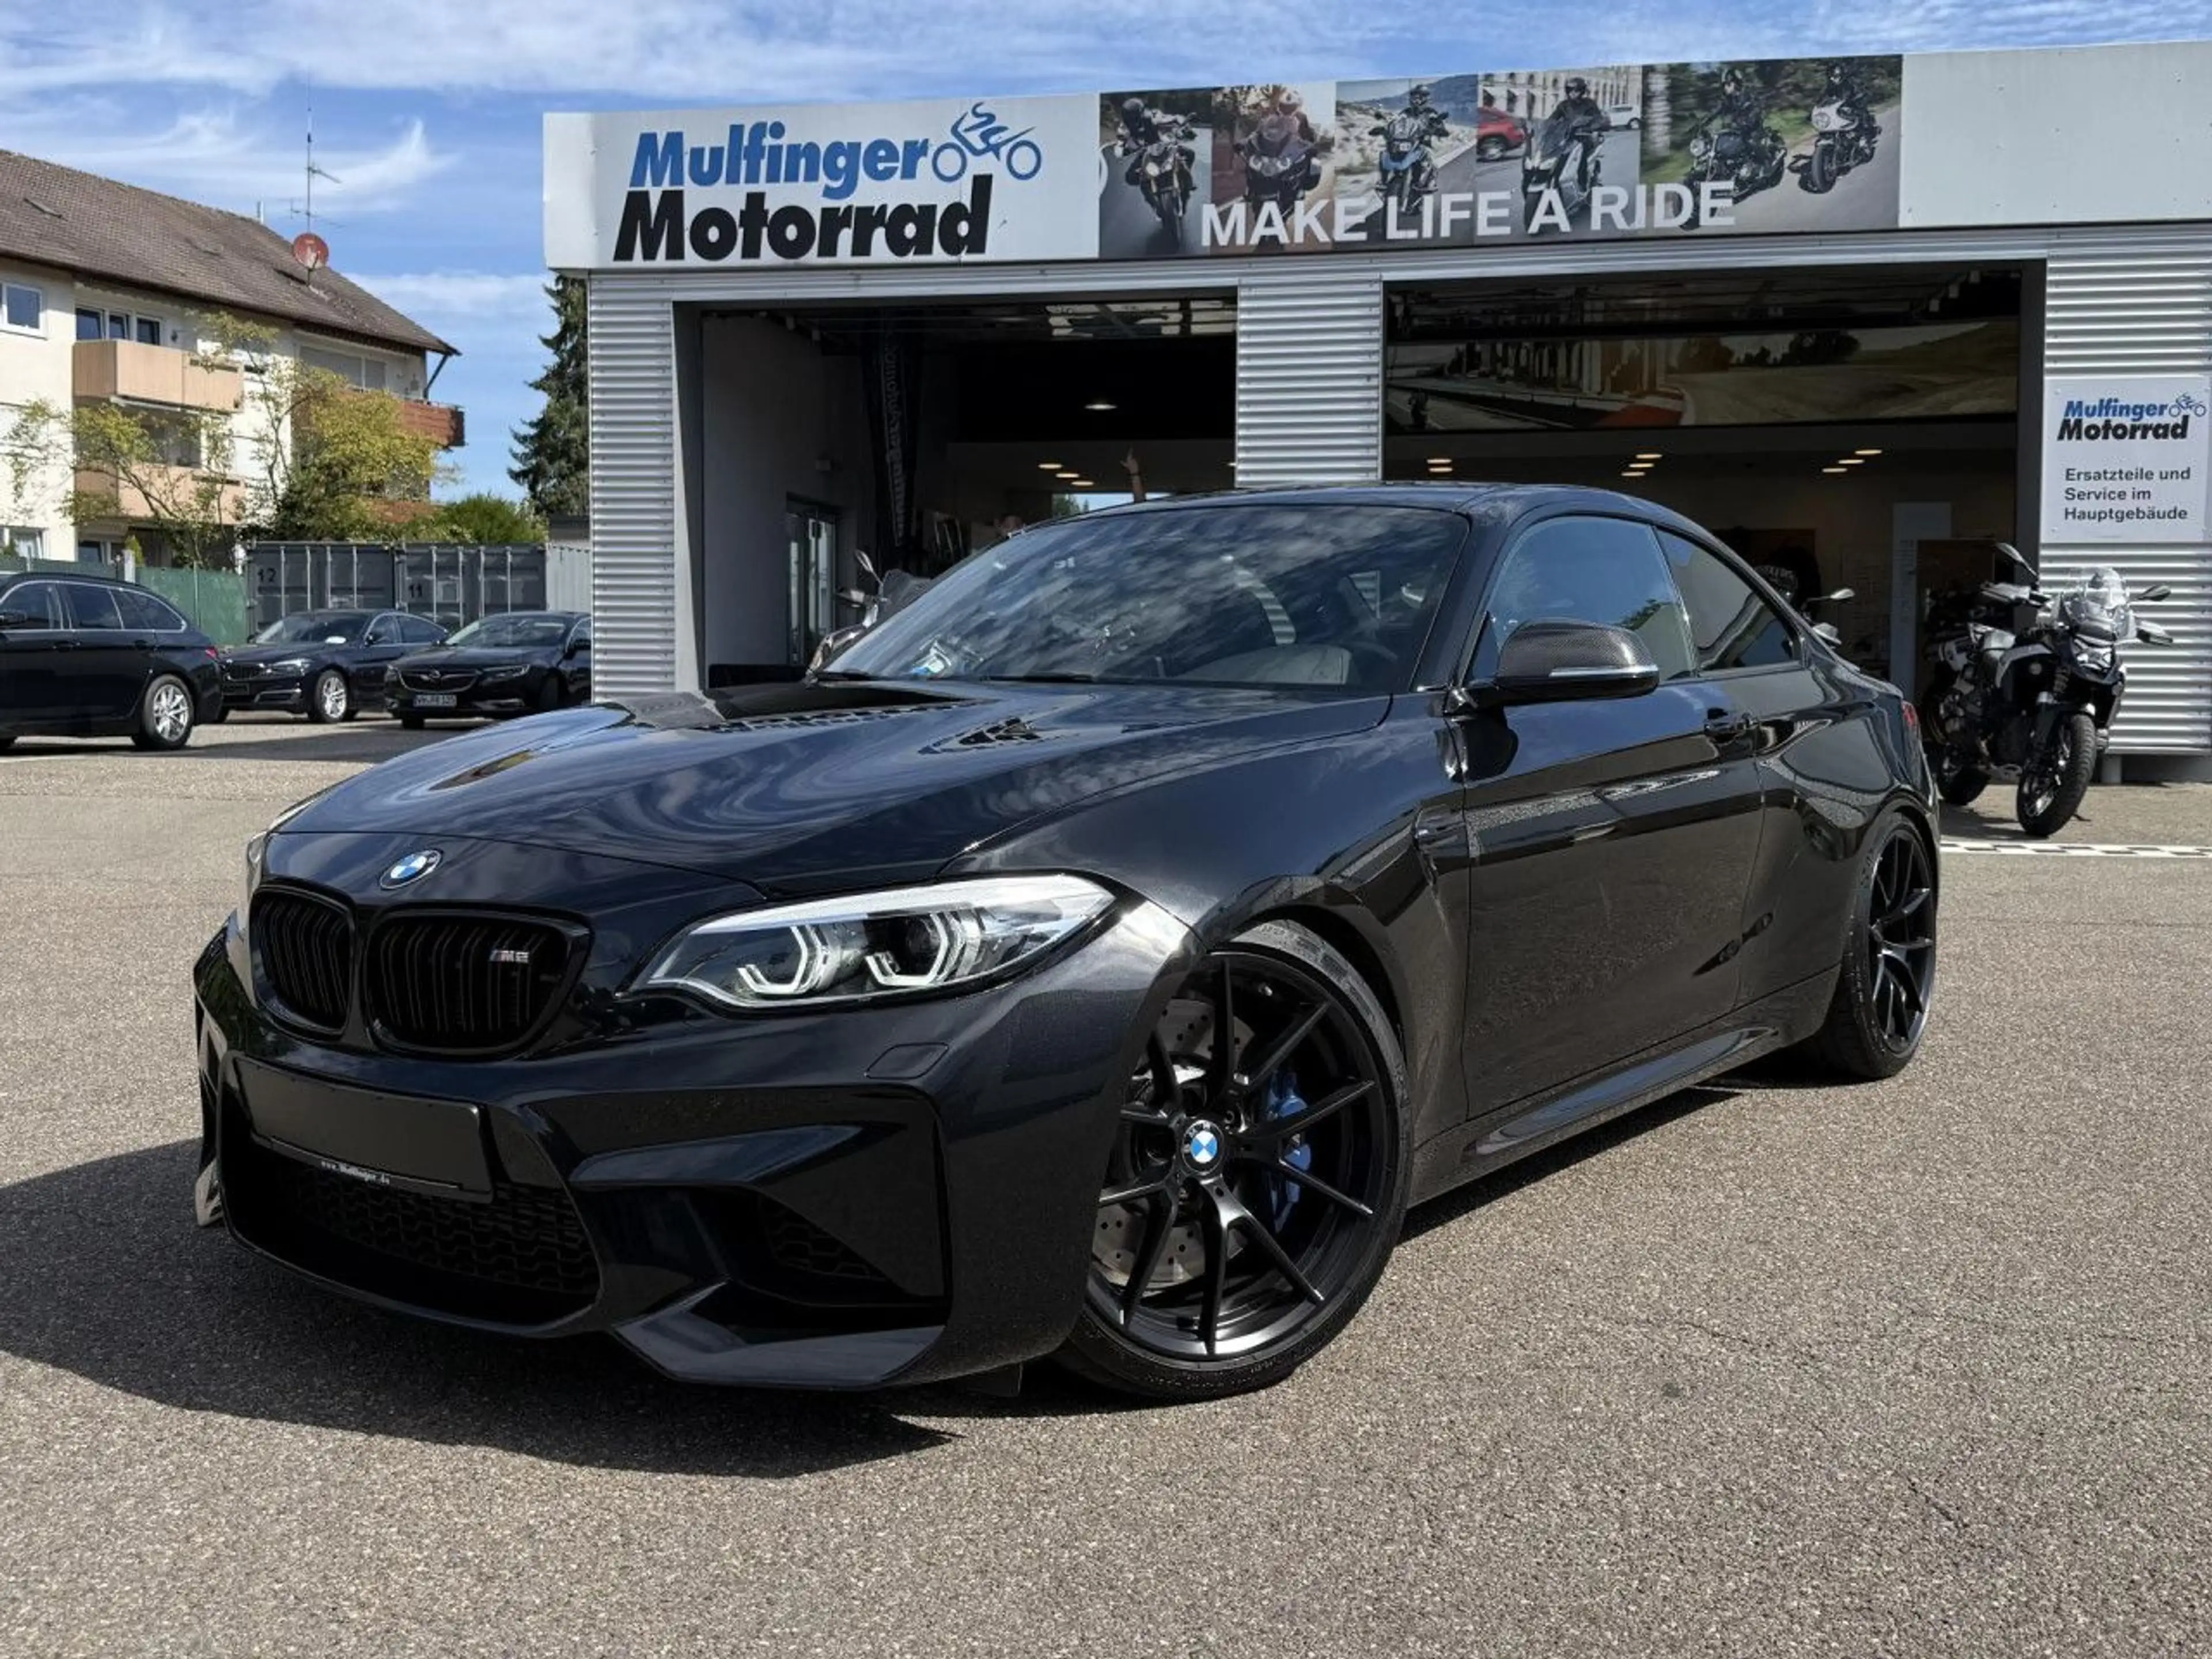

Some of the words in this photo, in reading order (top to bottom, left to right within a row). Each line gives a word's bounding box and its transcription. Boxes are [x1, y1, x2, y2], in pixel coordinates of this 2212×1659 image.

[630, 121, 929, 199] Mulfinger
[613, 174, 993, 262] Motorrad
[1202, 197, 1368, 247] MAKE
[1387, 192, 1511, 239] LIFE
[1528, 188, 1573, 234] A
[1591, 181, 1736, 230] RIDE
[2065, 398, 2168, 421] Mulfinger
[2056, 415, 2189, 441] Motorrad
[2065, 467, 2154, 482] Ersatzteile
[2160, 467, 2191, 480] und
[2065, 487, 2127, 500] Service
[2132, 487, 2151, 500] im
[2065, 506, 2188, 522] Hauptgebäude
[257, 568, 276, 582] 12
[408, 583, 423, 598] 11
